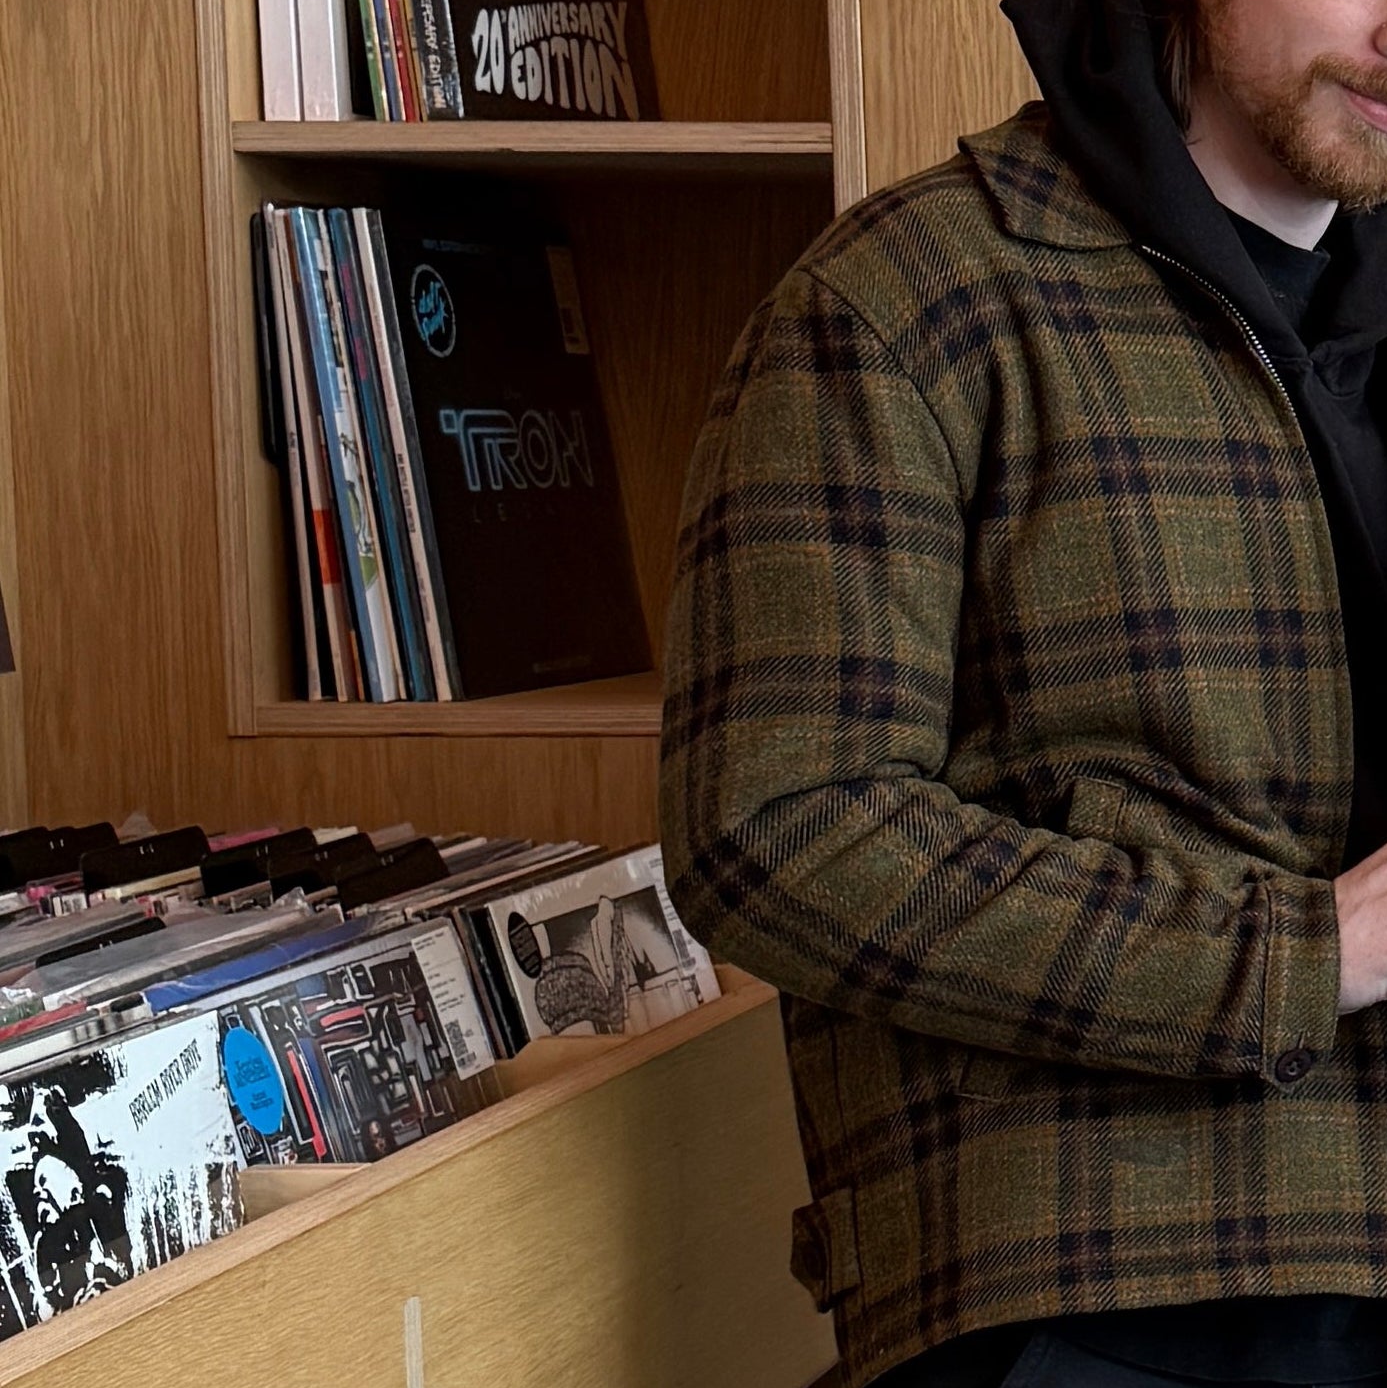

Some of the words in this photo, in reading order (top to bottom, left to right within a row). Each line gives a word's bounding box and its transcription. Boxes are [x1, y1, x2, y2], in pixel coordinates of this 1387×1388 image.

[508, 1, 628, 62] ANNIVERSARY
[511, 35, 640, 123] EDITION
[439, 409, 594, 491] TRON
